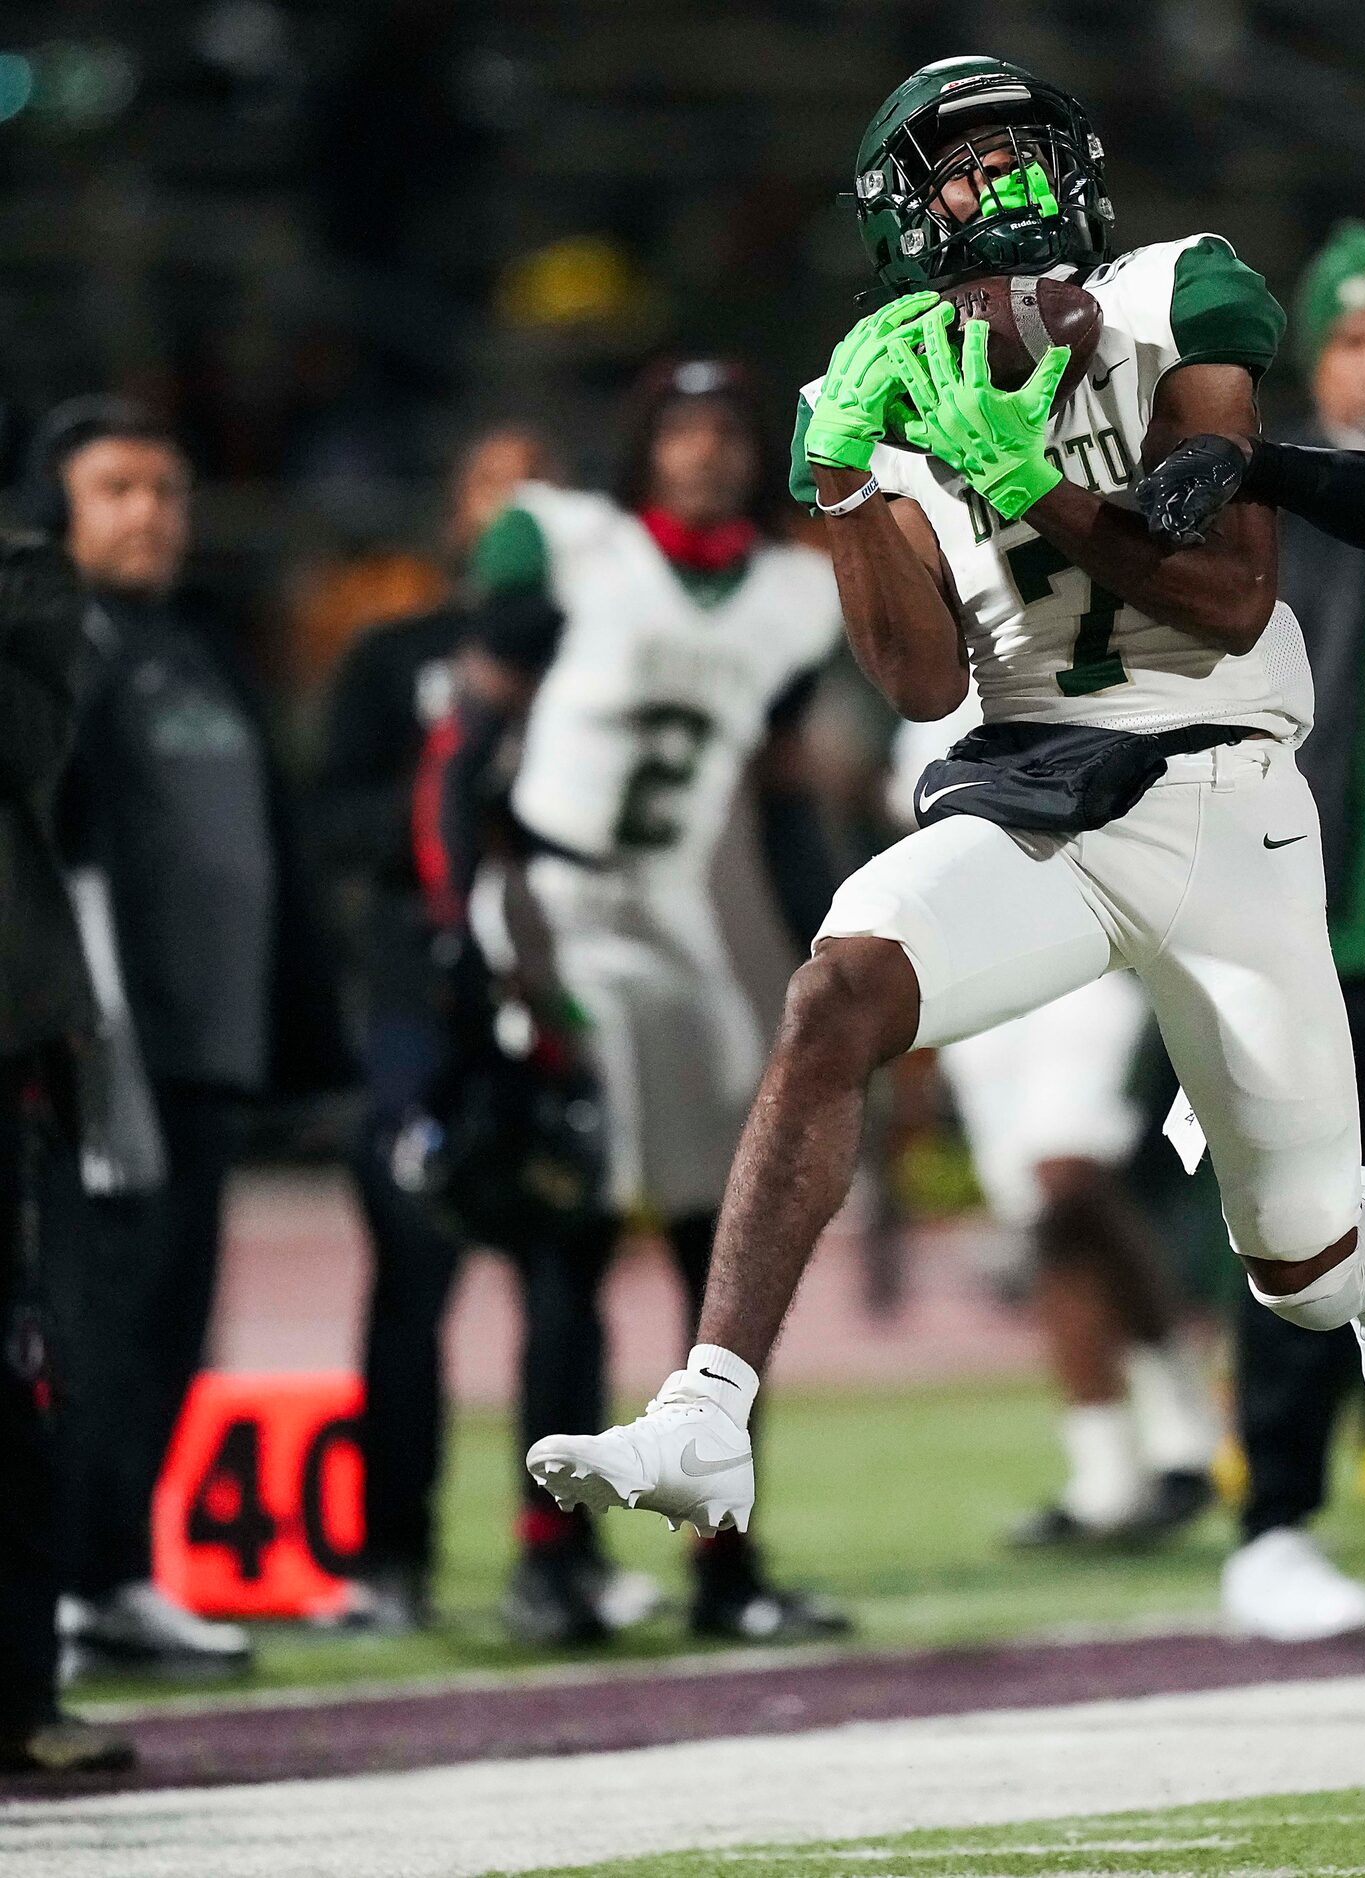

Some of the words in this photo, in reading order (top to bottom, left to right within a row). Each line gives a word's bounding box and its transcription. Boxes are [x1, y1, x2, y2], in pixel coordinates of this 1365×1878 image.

[1004, 535, 1131, 698] 7
[608, 700, 716, 852] 2
[187, 1416, 366, 1584] 40
